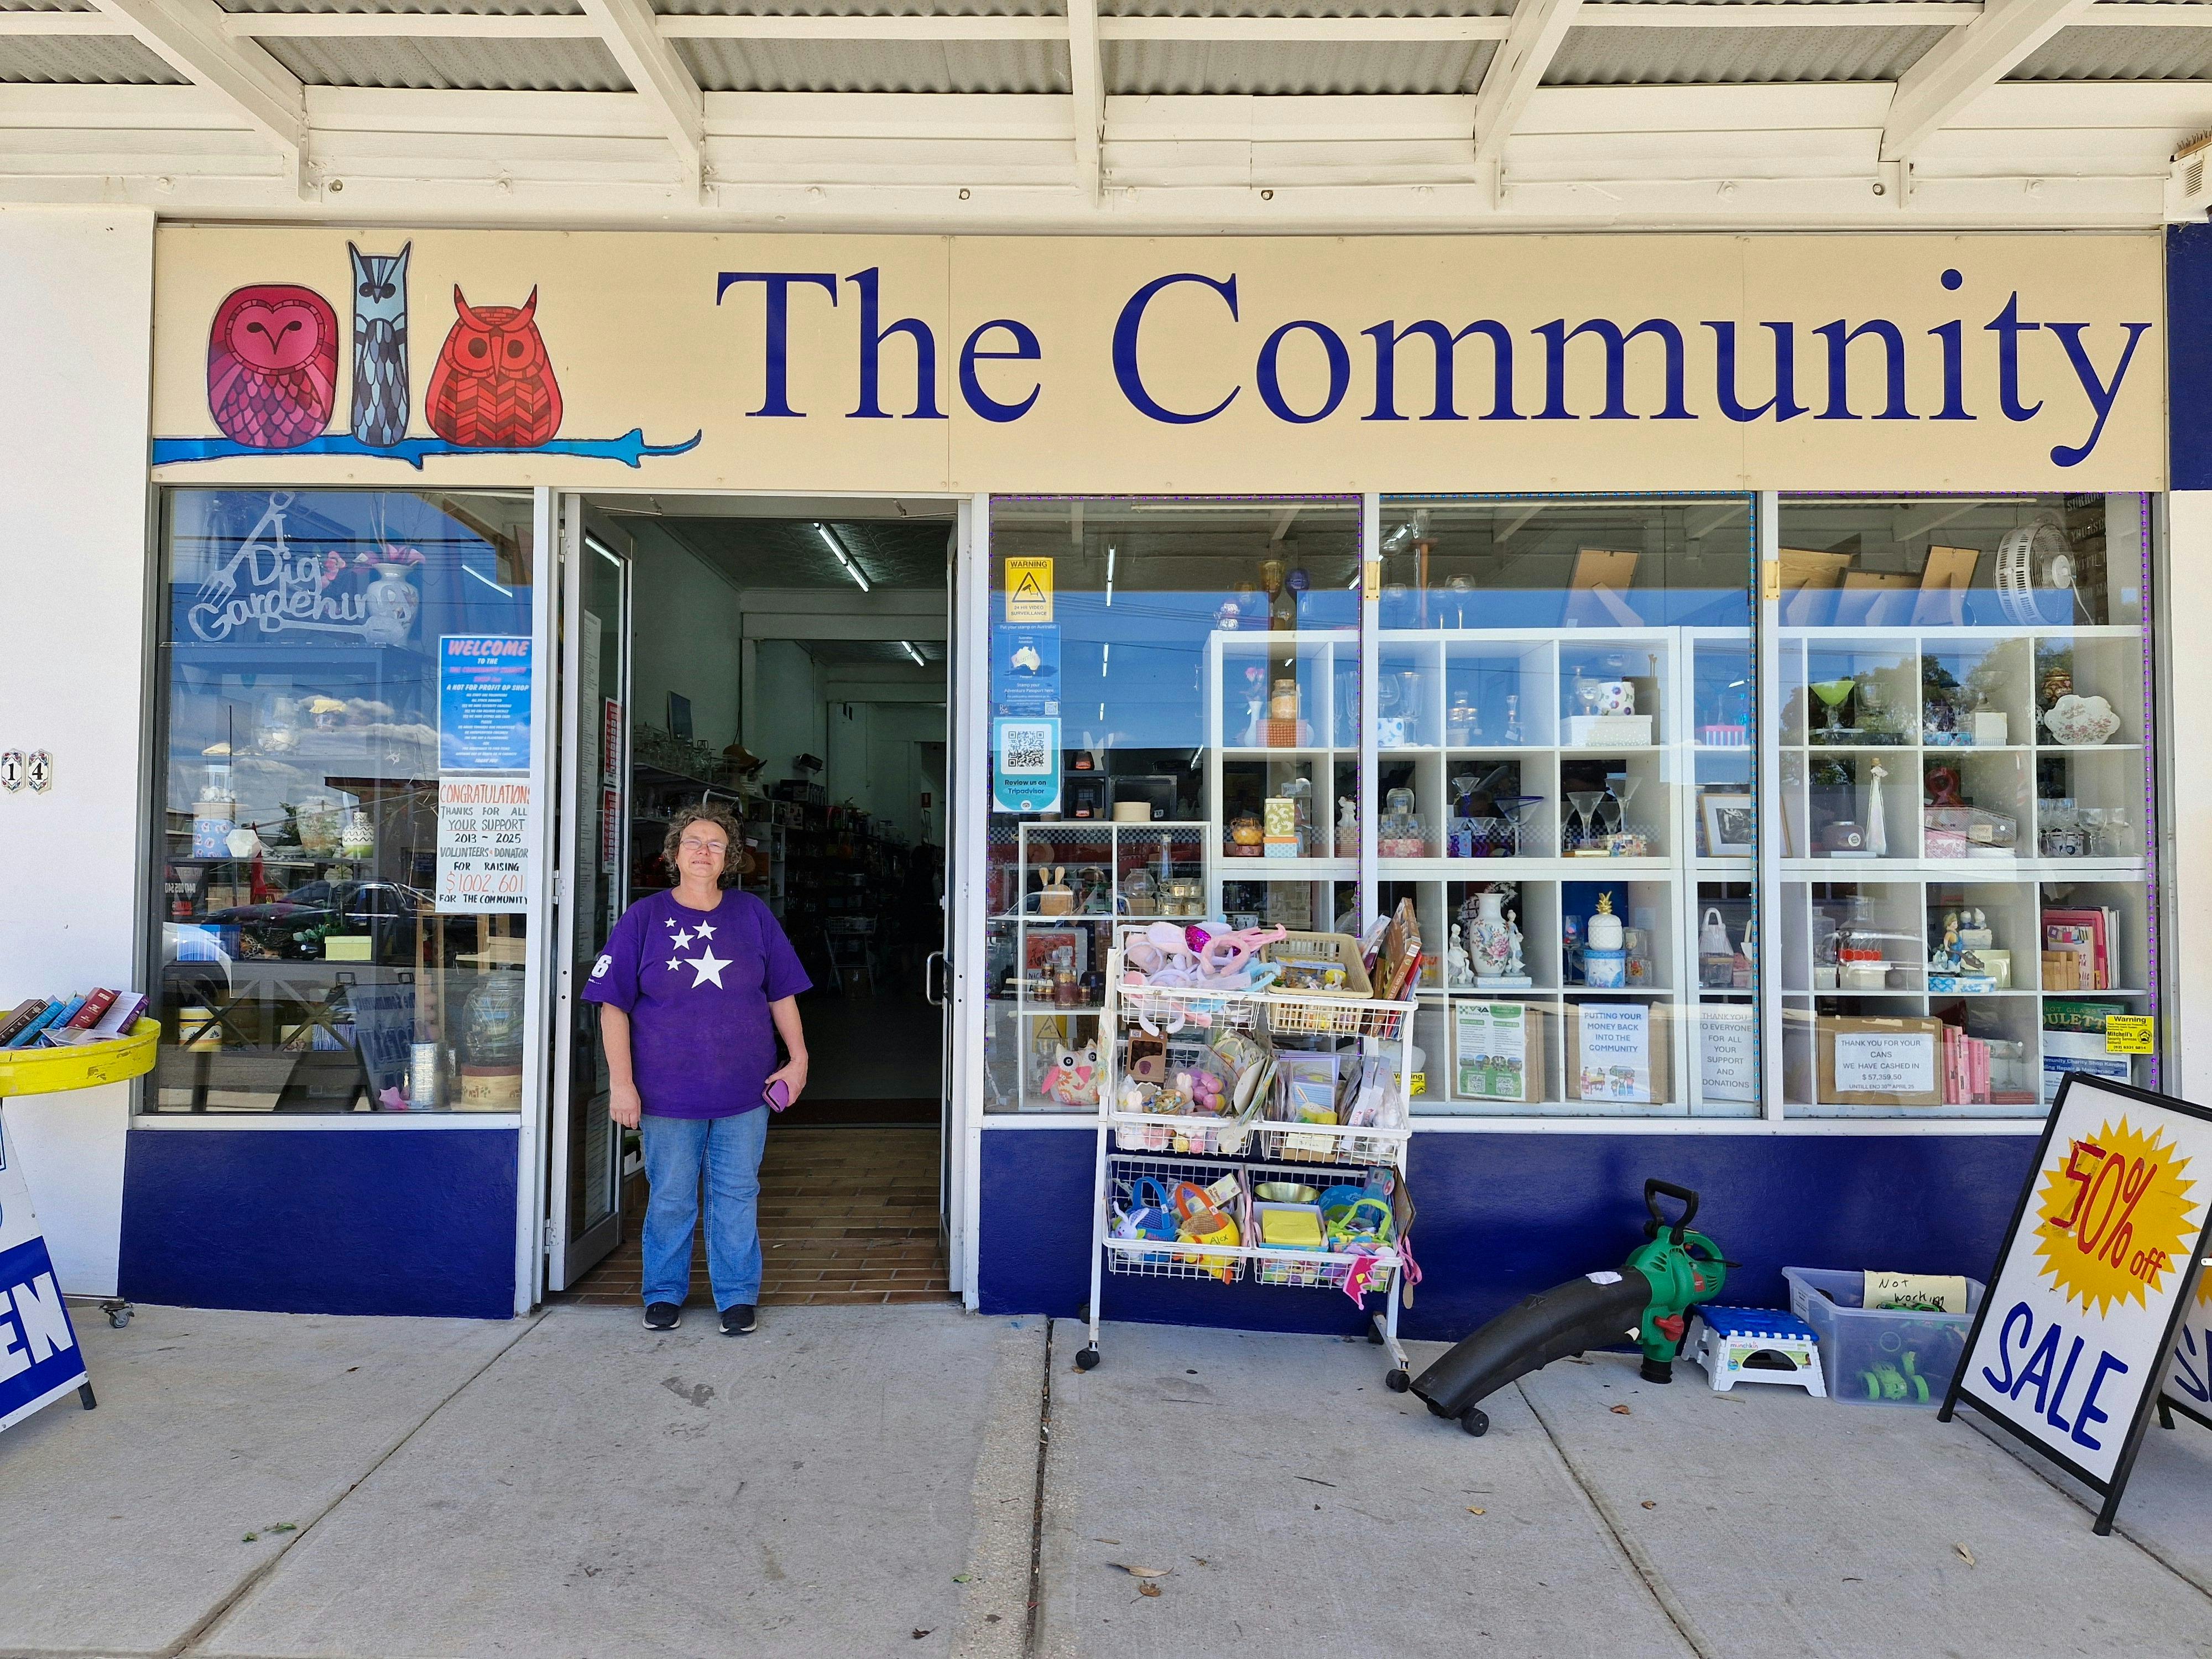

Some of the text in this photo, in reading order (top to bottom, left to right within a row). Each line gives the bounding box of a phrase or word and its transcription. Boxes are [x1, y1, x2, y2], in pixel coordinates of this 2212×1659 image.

[718, 268, 2151, 467] The Community
[247, 544, 324, 596] Dig
[188, 568, 412, 642] Gardening
[448, 640, 529, 656] WELCOME
[440, 806, 528, 820] THANKS FOR ALL
[448, 819, 526, 831] YOUR SUPPORT
[455, 833, 521, 843] 2013 2025
[440, 847, 489, 858] VOLUNTEERS
[453, 862, 520, 872] FOR RAISING
[439, 894, 528, 905] FOR THE COMMUNITY
[1395, 971, 1405, 986] MOULD
[2114, 1016, 2146, 1024] Warning
[1710, 1024, 1752, 1032] EVERYONE
[1589, 1044, 1638, 1052] COMMUNITY
[1707, 1056, 1743, 1065] SUPPORT
[1702, 1079, 1750, 1088] DONATIONS
[2048, 1140, 2158, 1270] 50%
[1210, 1234, 1229, 1245] Alex
[2129, 1246, 2167, 1285] off
[1879, 1278, 1910, 1289] Not
[1983, 1301, 2129, 1452] SALE
